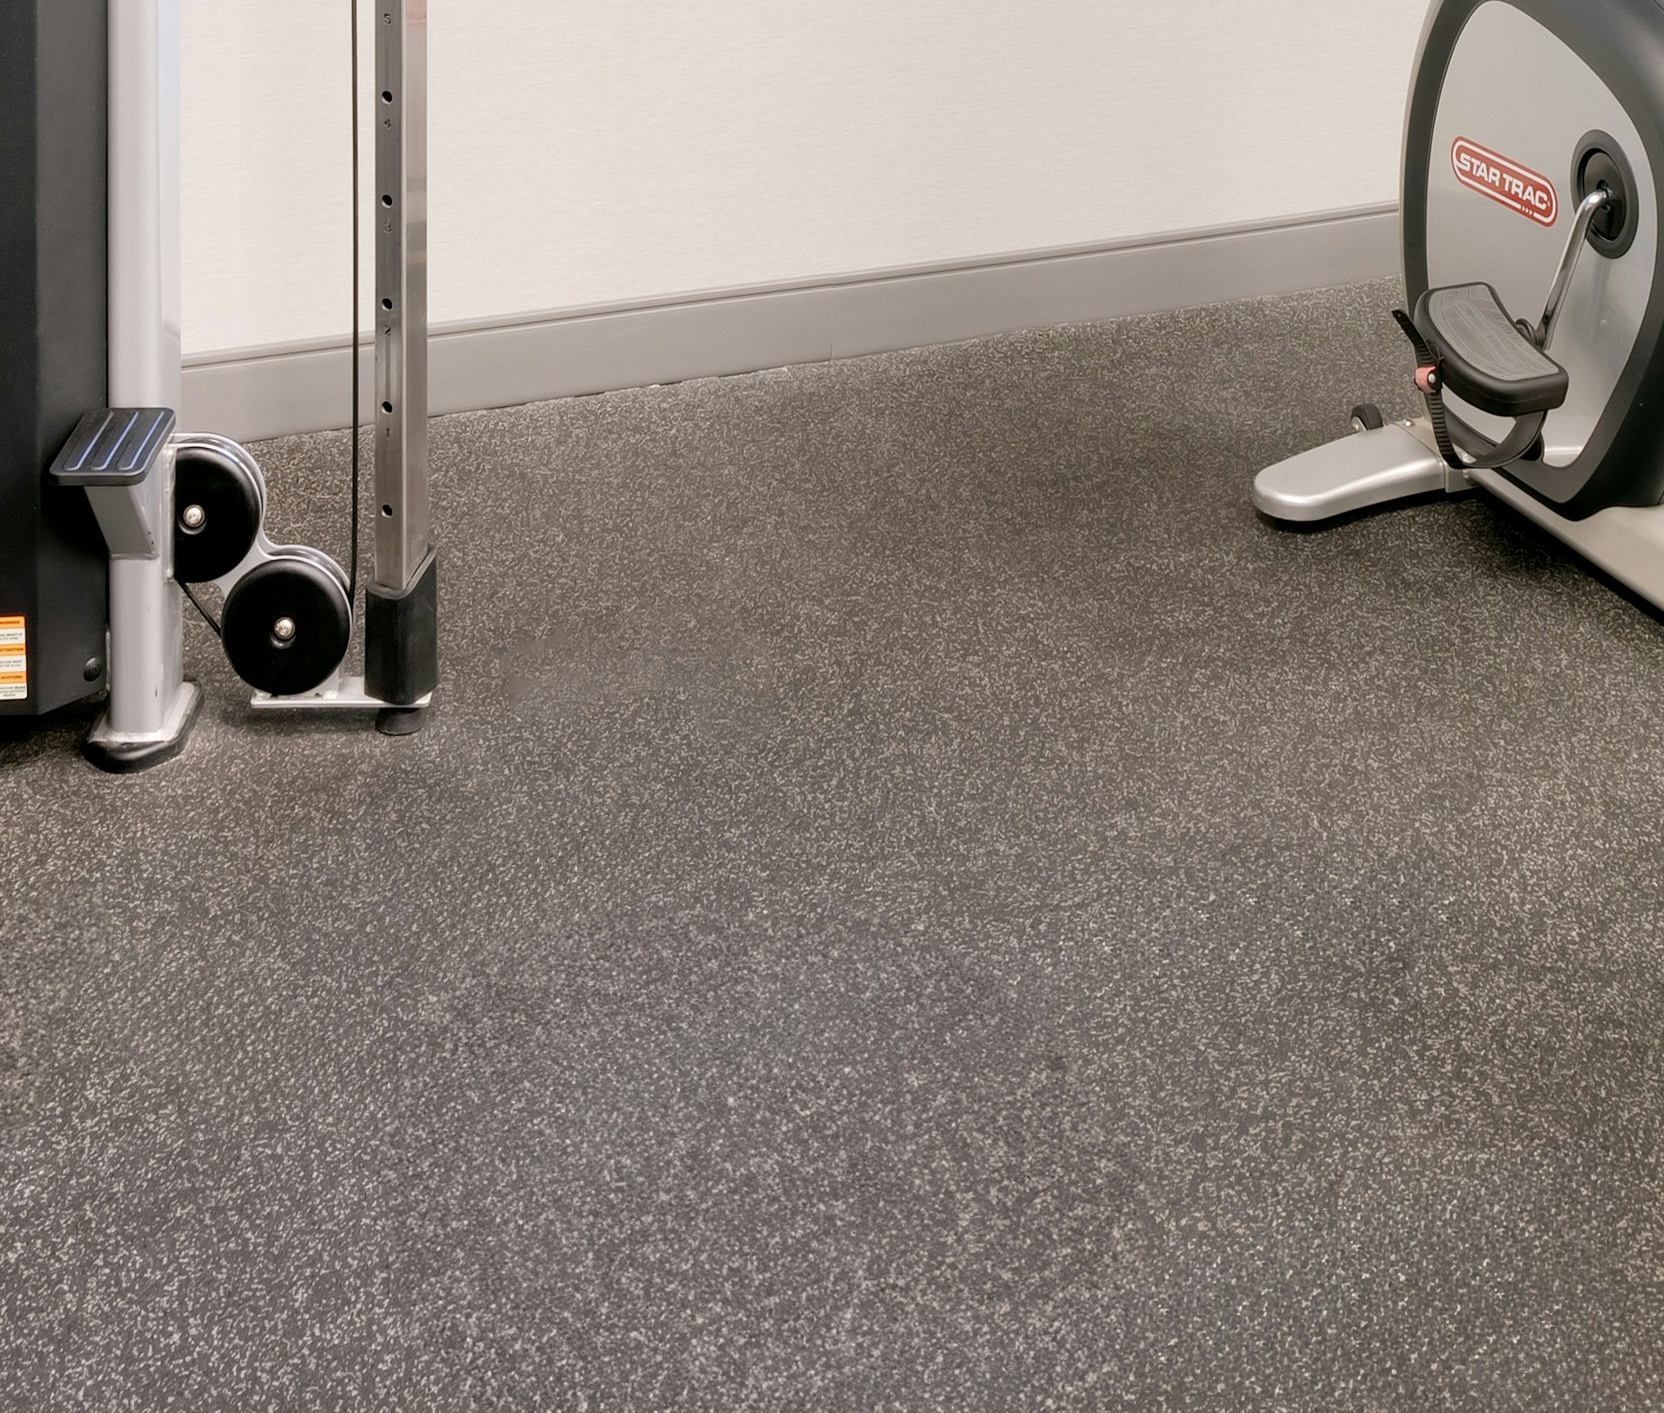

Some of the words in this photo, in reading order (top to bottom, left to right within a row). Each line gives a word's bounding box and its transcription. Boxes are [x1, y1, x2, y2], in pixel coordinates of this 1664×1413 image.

[384, 13, 391, 24] 5
[384, 118, 391, 128] 4
[1458, 152, 1500, 187] STAR
[1502, 172, 1548, 210] TRAC
[384, 325, 391, 335] 2
[386, 428, 390, 438] 1
